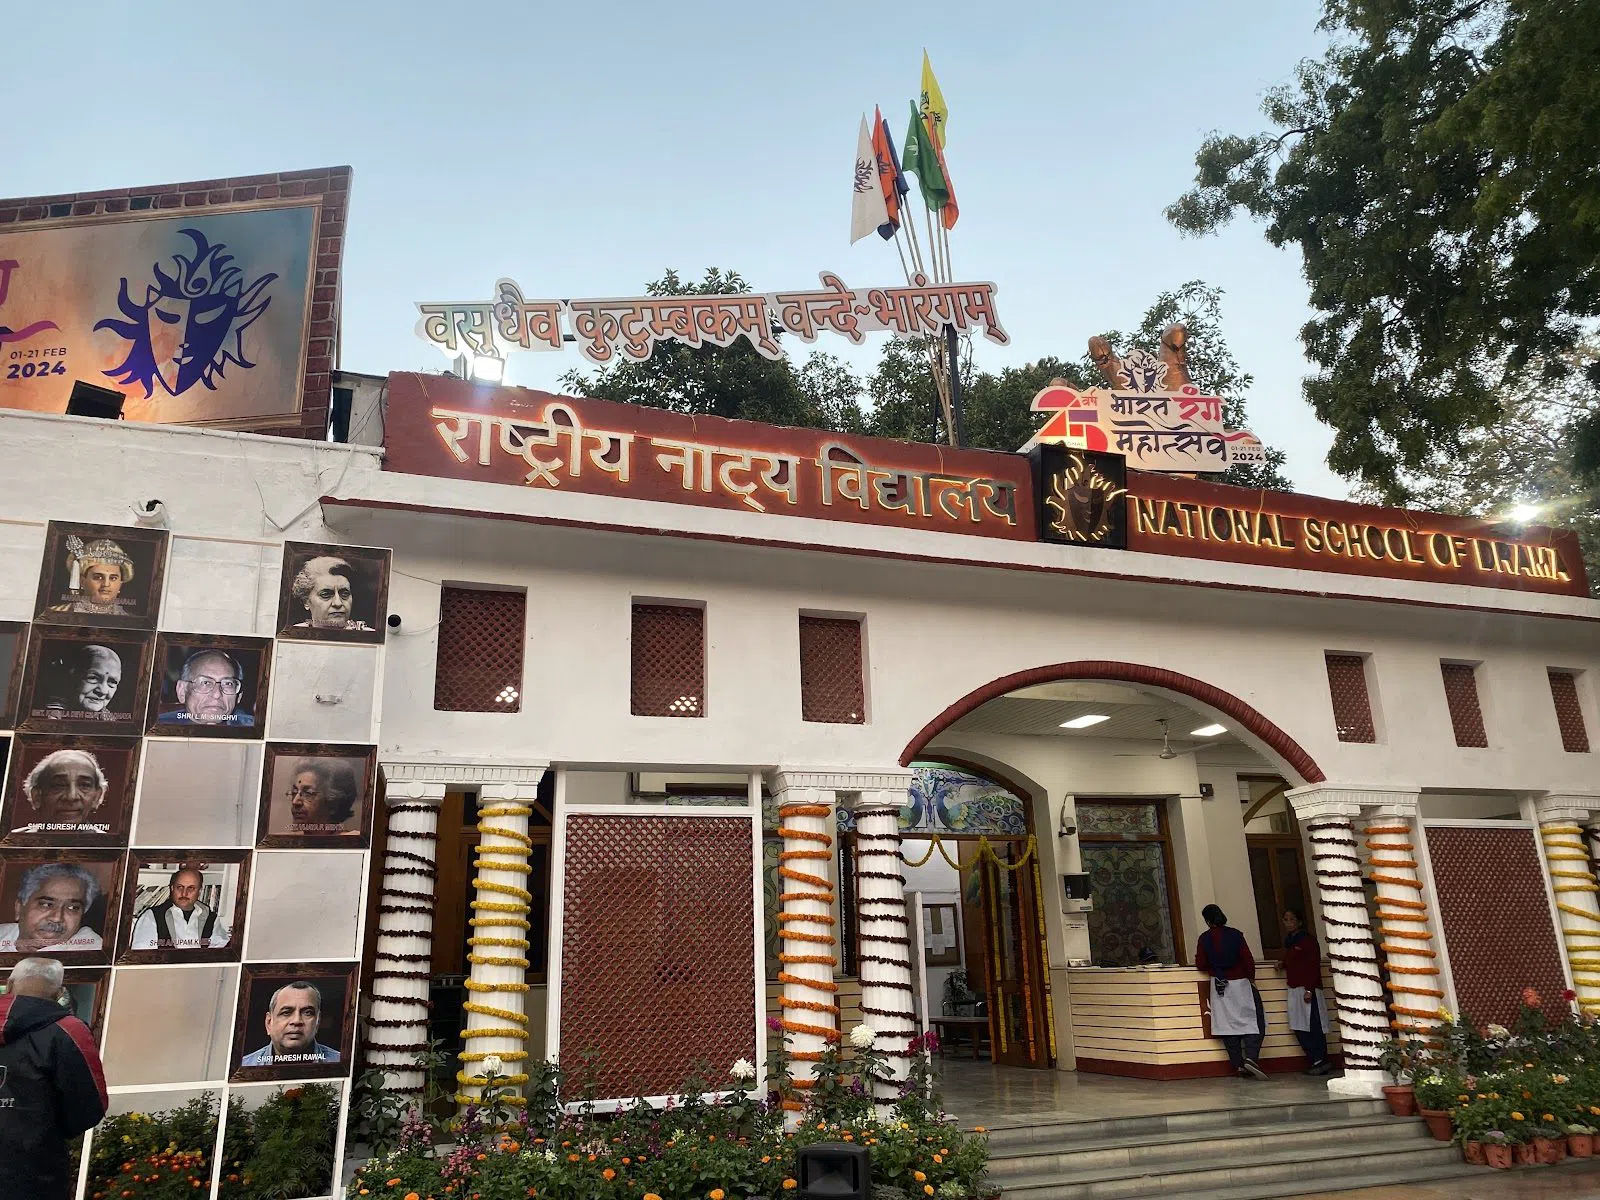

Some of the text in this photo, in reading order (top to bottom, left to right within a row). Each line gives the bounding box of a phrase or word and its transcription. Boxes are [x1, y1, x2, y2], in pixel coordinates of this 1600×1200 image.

[570, 296, 780, 362] कुटुम्बकम्
[10, 347, 67, 360] 01-21 FEB
[7, 360, 66, 379] 2024
[1110, 386, 1224, 424] भारत रंग
[1110, 420, 1228, 462] महोत्सव
[432, 402, 1018, 526] राष्ट्रीय नाट्य विद्यालय
[1232, 452, 1263, 461] 2024
[1127, 495, 1296, 550] NATIONAL
[1303, 517, 1425, 564] SCHOOL
[1429, 532, 1467, 568] OF
[176, 712, 194, 720] SHRI
[77, 823, 110, 831] AWASTHI
[165, 938, 193, 947] AUPAM
[257, 1053, 327, 1063] SHRI PARESH RAWAL
